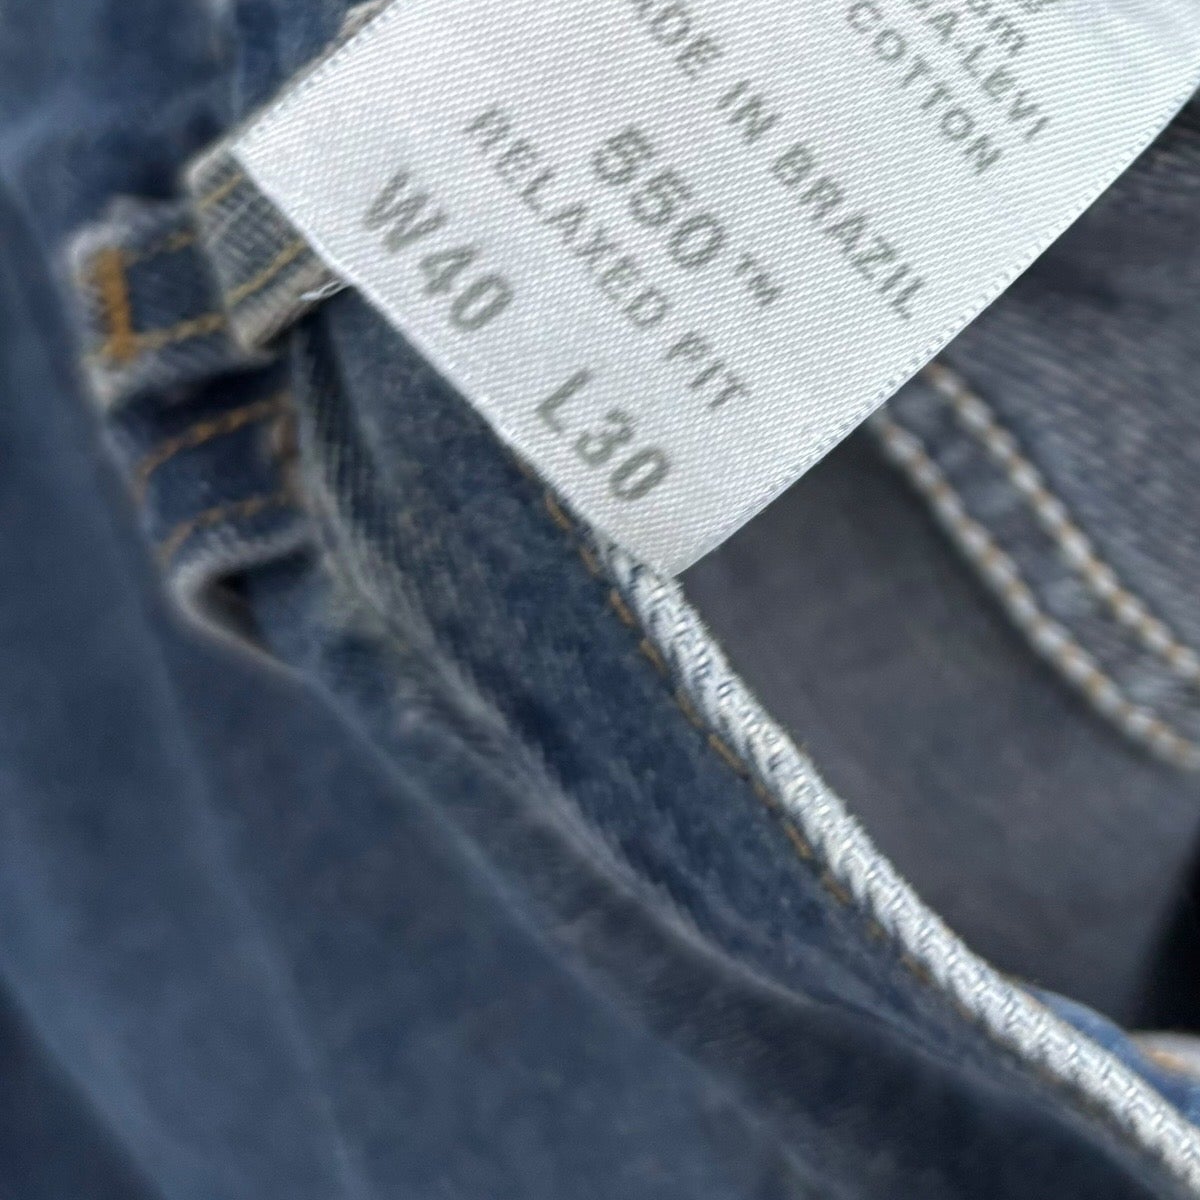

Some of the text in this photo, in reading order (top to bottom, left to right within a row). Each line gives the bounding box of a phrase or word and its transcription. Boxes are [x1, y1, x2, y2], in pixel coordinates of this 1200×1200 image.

[718, 79, 783, 144] IN
[771, 142, 925, 320] BRAZIL
[846, 0, 1002, 175] COTTON
[363, 170, 671, 502] W40 L30
[465, 106, 750, 411] RELAXED FIT
